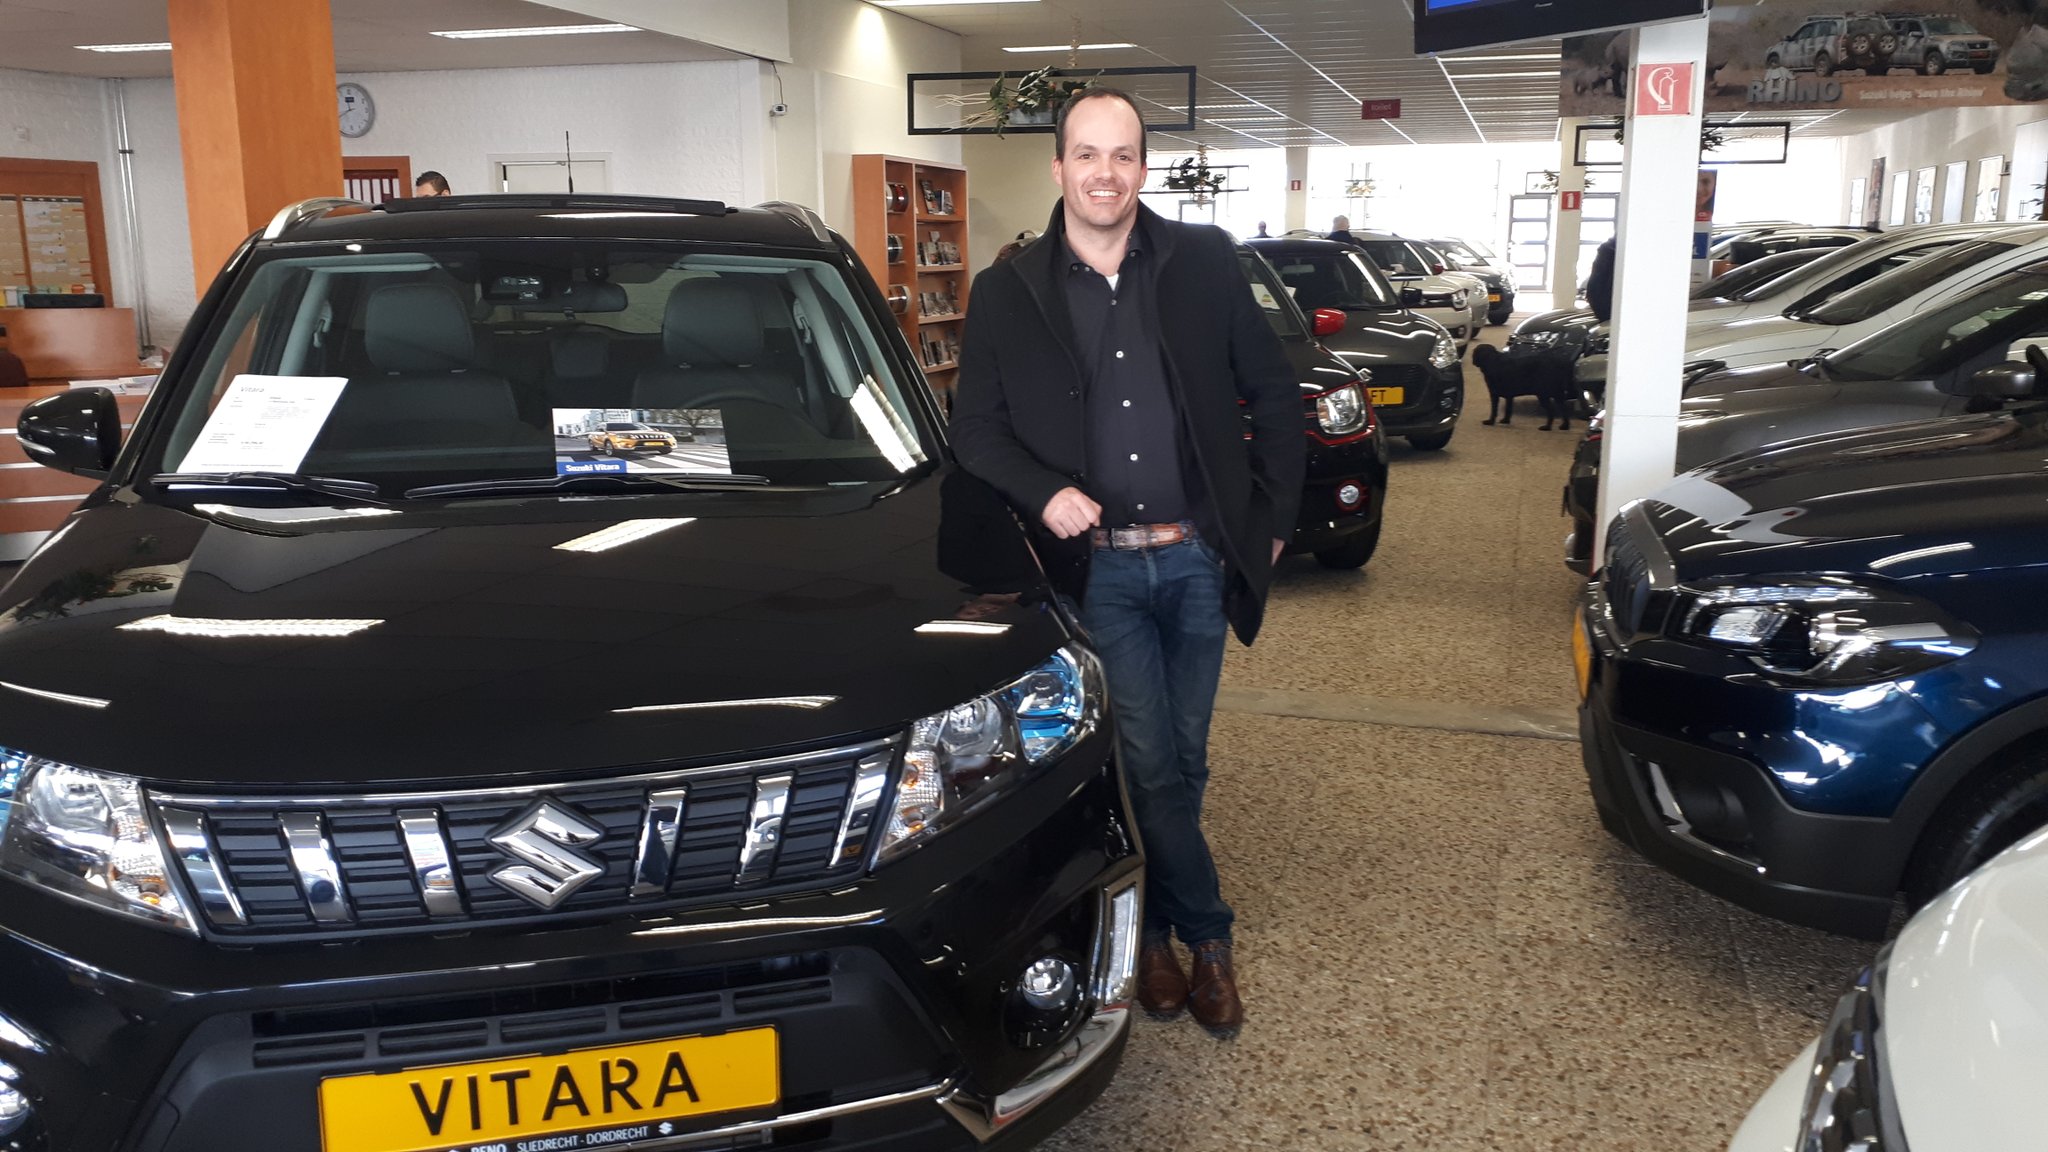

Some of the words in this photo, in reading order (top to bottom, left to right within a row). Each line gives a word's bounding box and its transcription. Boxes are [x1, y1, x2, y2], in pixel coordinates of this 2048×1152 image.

[1746, 78, 1842, 102] RHINO
[1859, 89, 1887, 100] Suzuki
[1888, 89, 1912, 100] helps
[565, 464, 593, 472] Suzuki
[410, 1051, 700, 1136] VITARA
[516, 1135, 579, 1152] SLIEDRECHT
[586, 1126, 649, 1145] DORDRECHT
